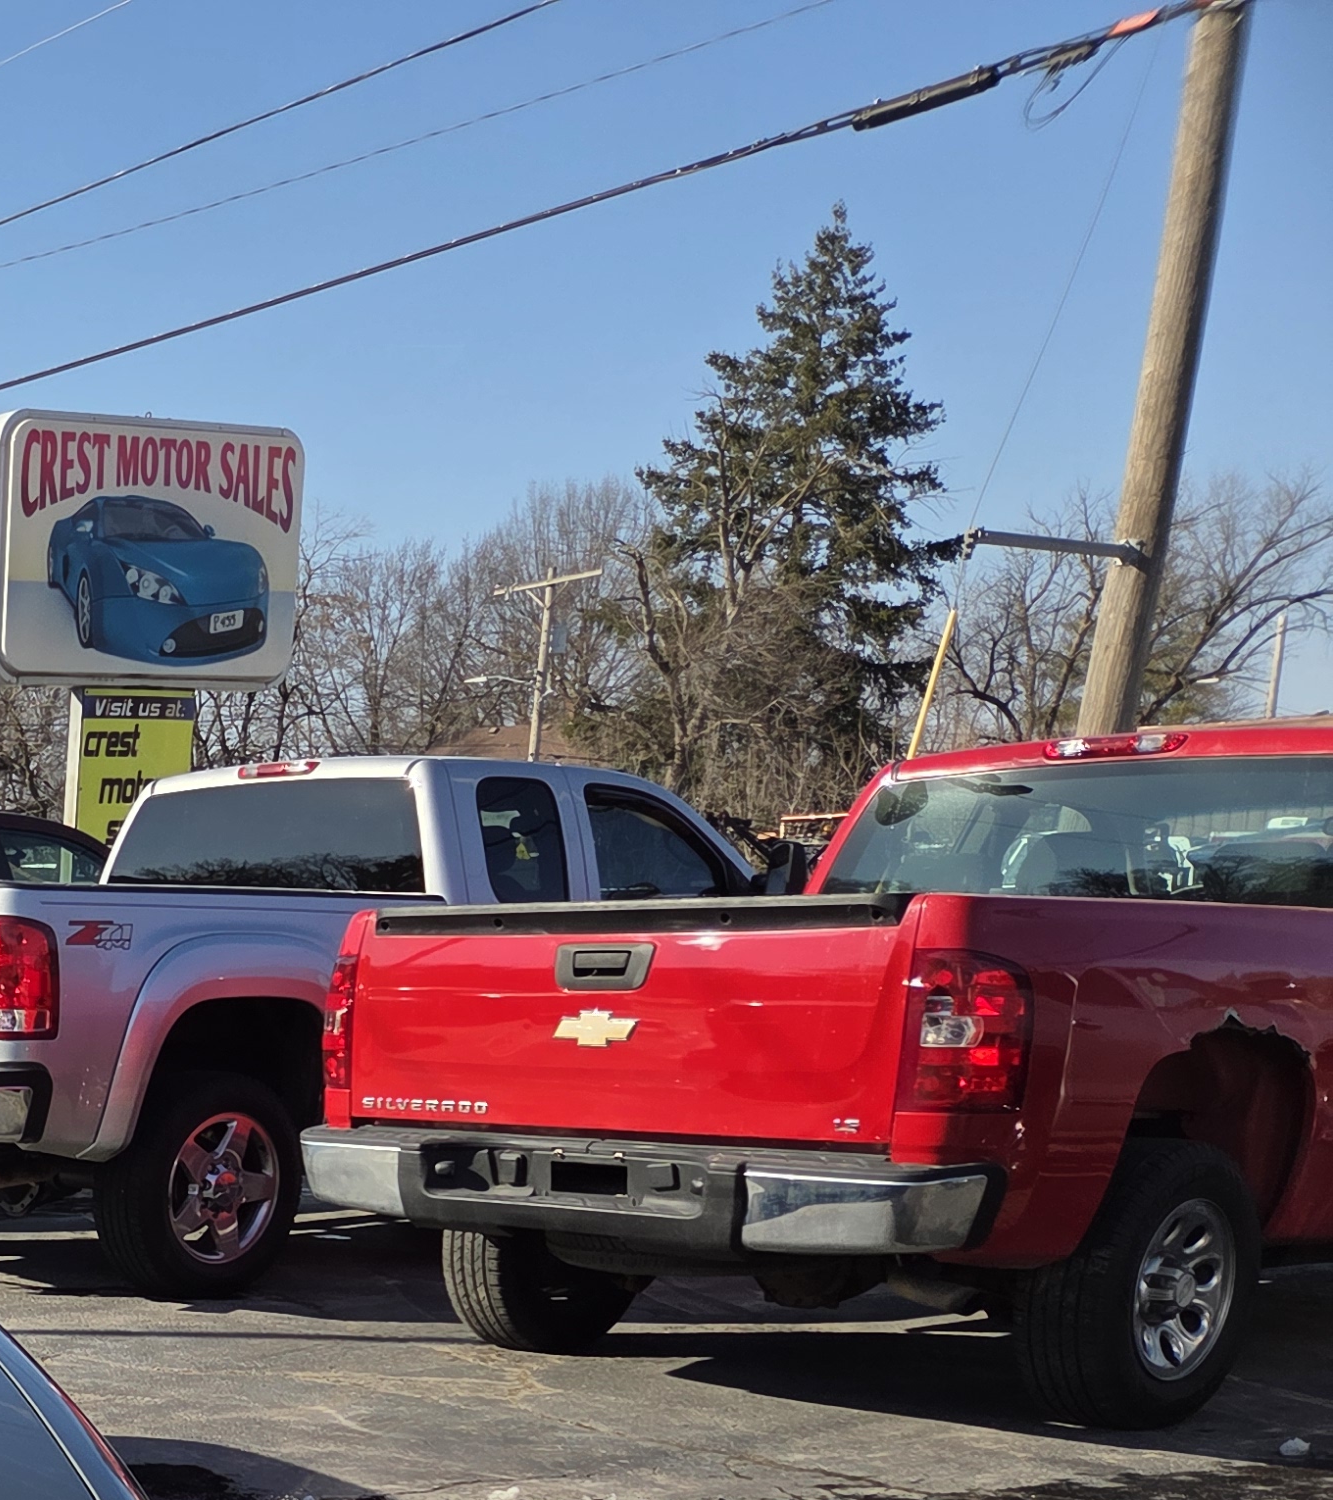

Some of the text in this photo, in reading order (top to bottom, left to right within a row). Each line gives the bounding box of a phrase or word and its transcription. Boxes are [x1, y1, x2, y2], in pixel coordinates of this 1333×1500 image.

[21, 428, 296, 533] CREST MOTOR SALES
[95, 699, 134, 717] Visit
[138, 702, 162, 717] us
[83, 723, 141, 758] crest
[361, 1096, 488, 1114] SILVERADO
